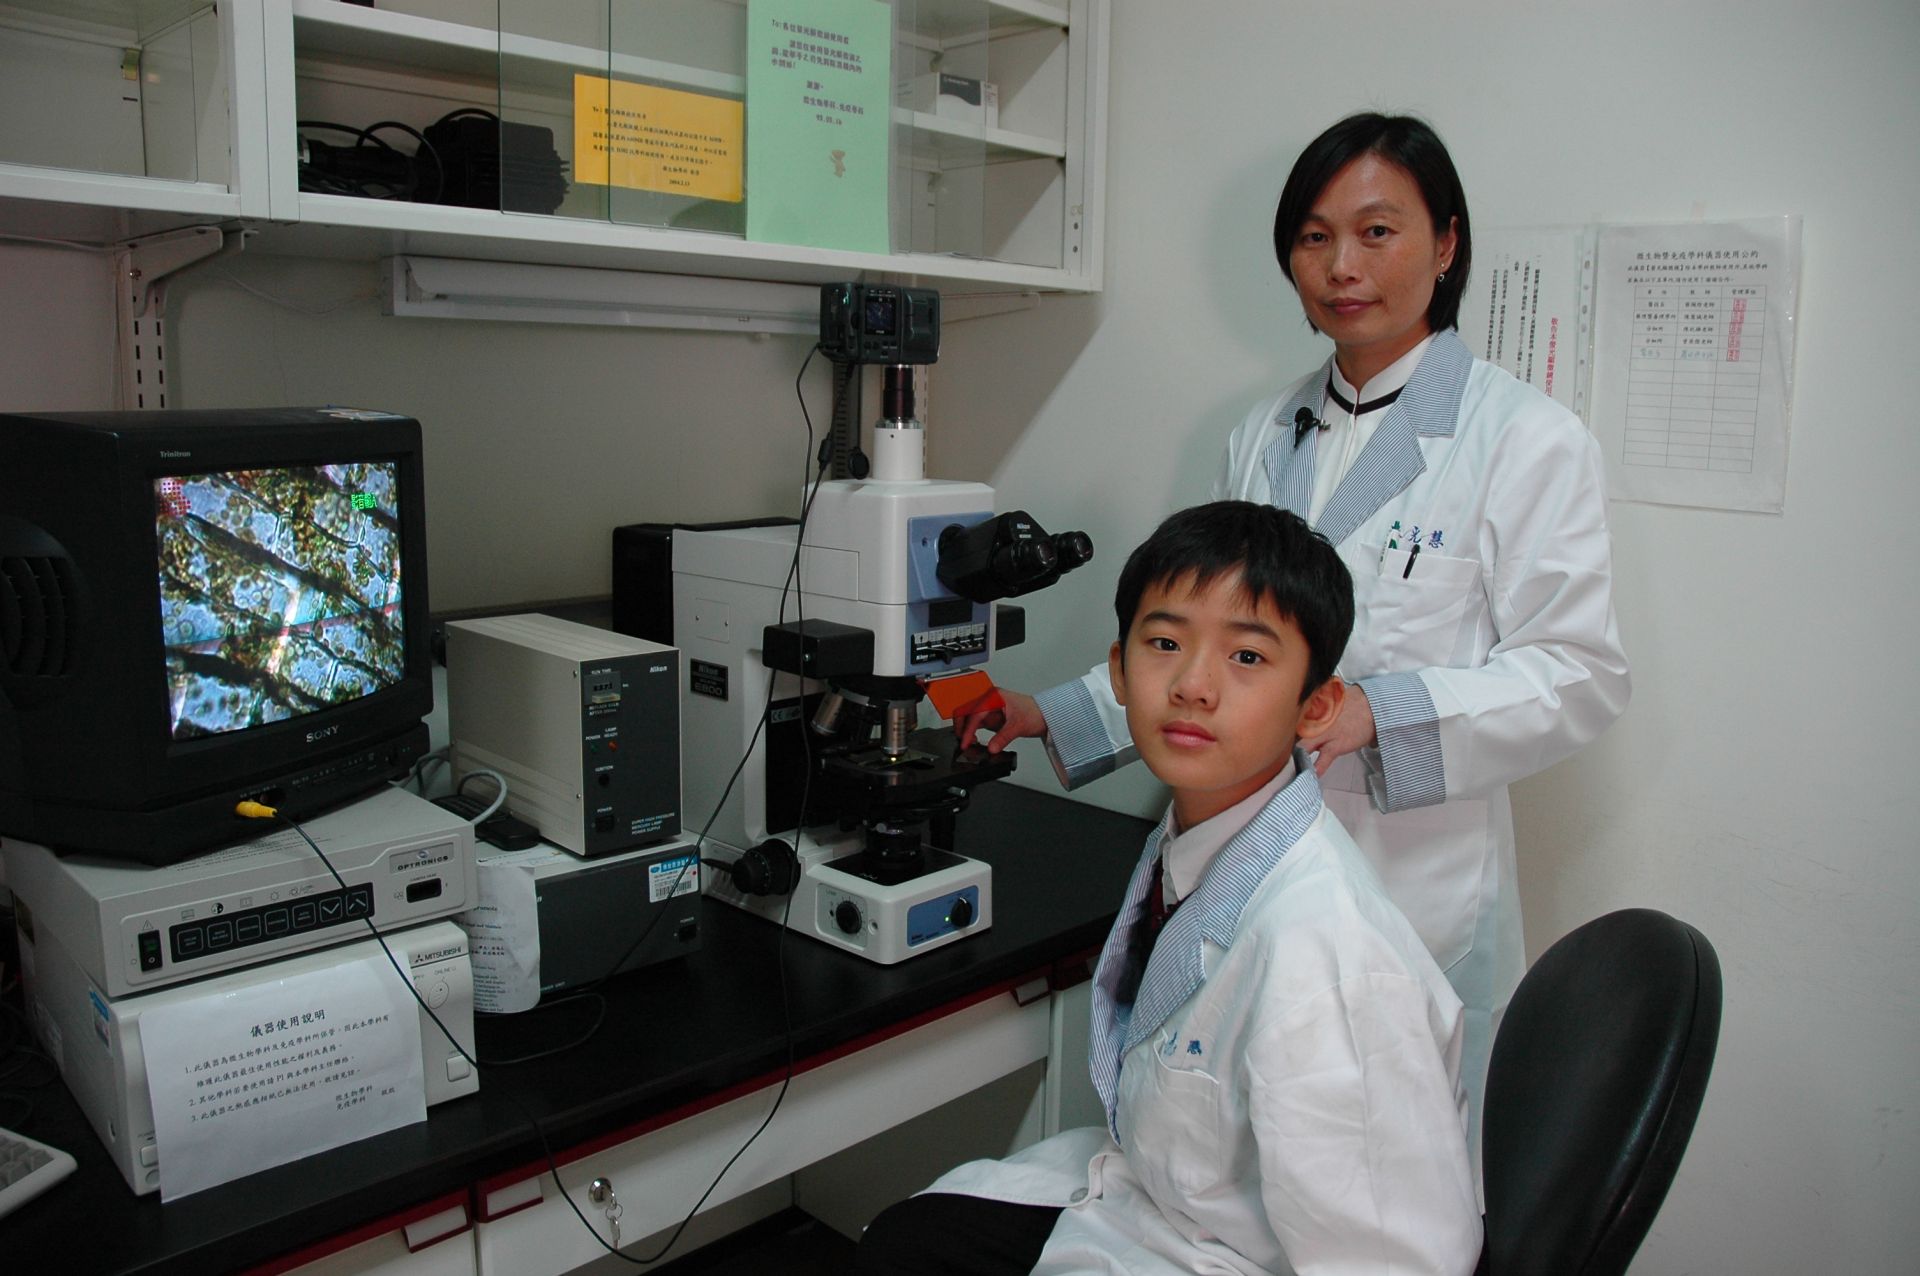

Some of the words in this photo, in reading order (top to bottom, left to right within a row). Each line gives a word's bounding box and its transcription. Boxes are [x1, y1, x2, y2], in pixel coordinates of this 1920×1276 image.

[1544, 317, 1559, 397] 敬告本螢光顯微鏡使用
[305, 725, 340, 743] SONY
[397, 855, 449, 871] OPTRONICS
[424, 946, 462, 961] MITSUBISHI
[250, 1009, 325, 1038] 儀器使用說明
